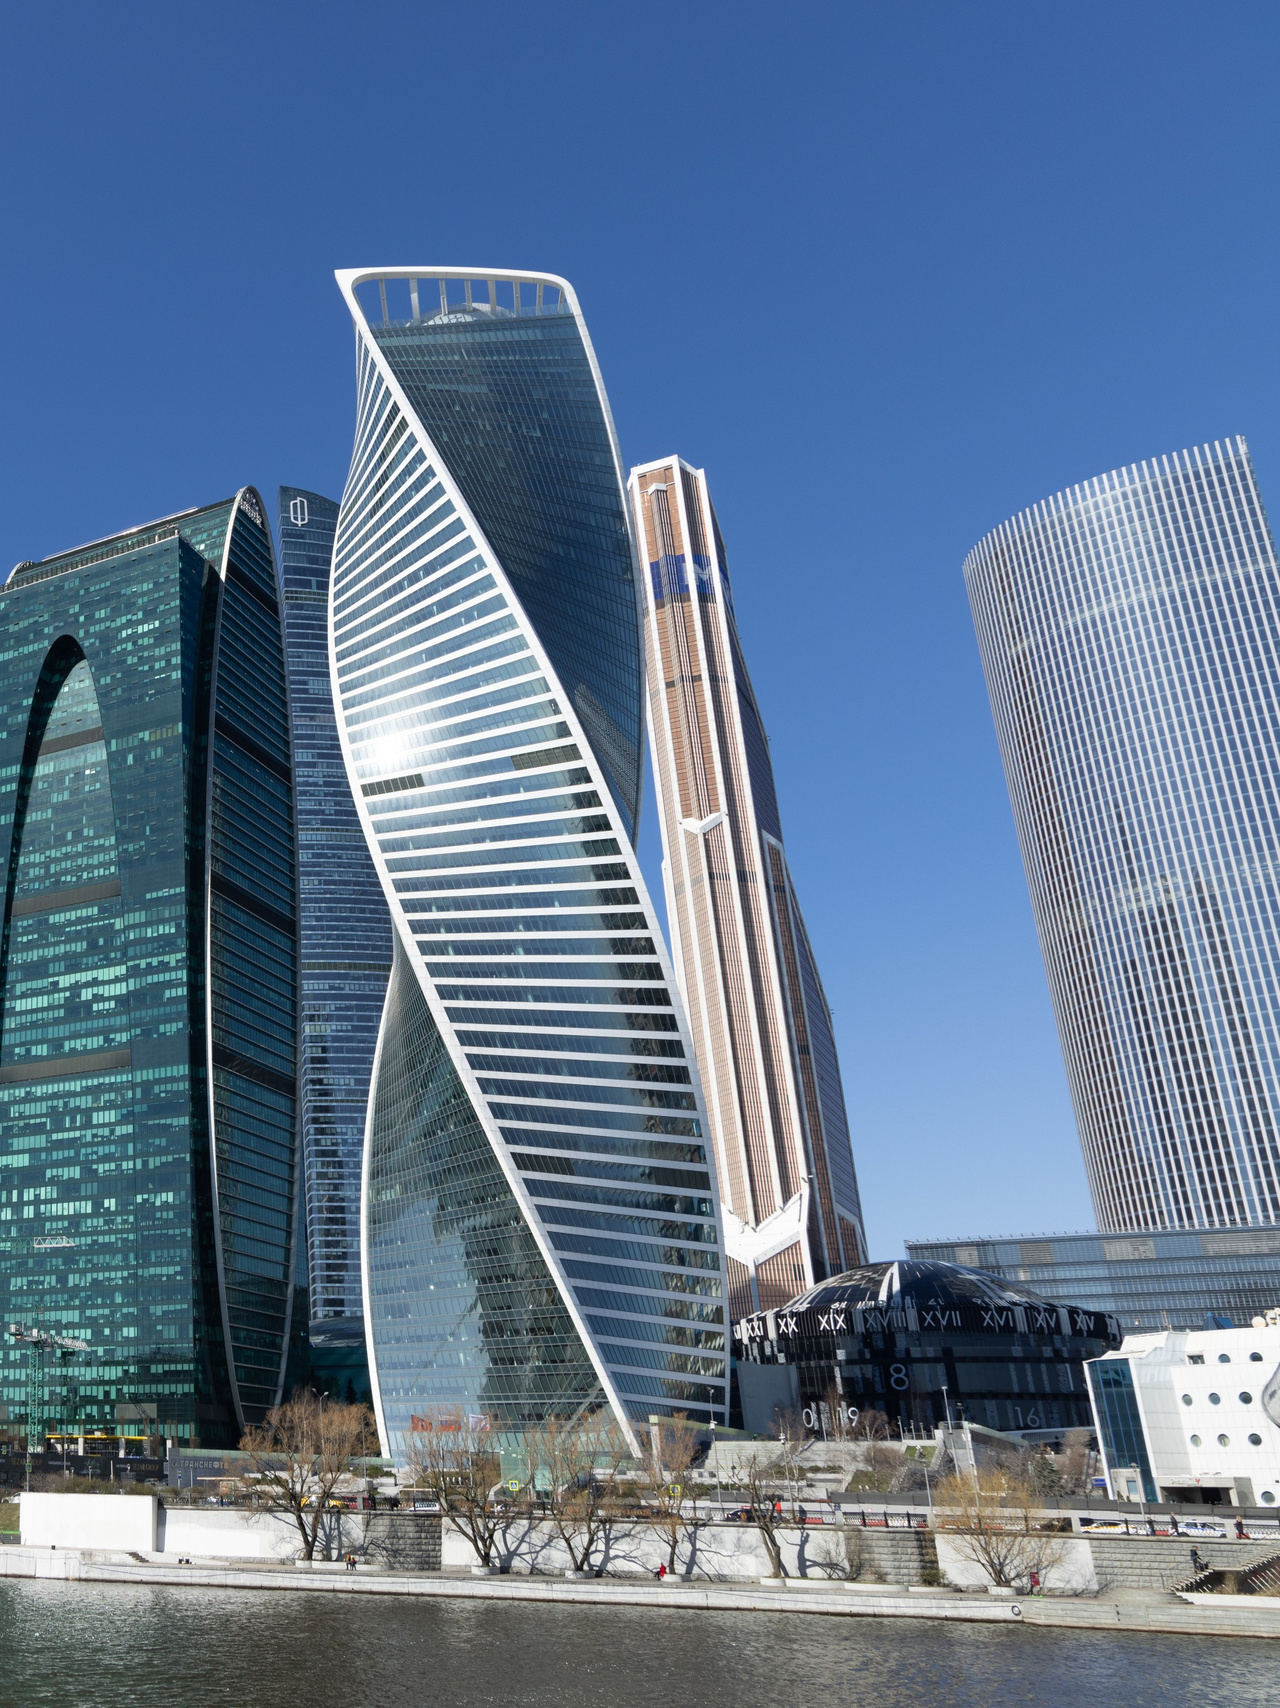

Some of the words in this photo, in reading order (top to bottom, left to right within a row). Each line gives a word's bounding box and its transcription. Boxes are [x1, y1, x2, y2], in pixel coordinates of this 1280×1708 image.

[777, 1317, 799, 1334] XX
[817, 1313, 848, 1331] XIX
[864, 1312, 907, 1328] XVIII
[921, 1310, 962, 1327] XVII
[980, 1310, 1014, 1327] XVI
[1033, 1311, 1057, 1329] XV
[1074, 1313, 1095, 1331] XIV
[1014, 1406, 1040, 1428] 16
